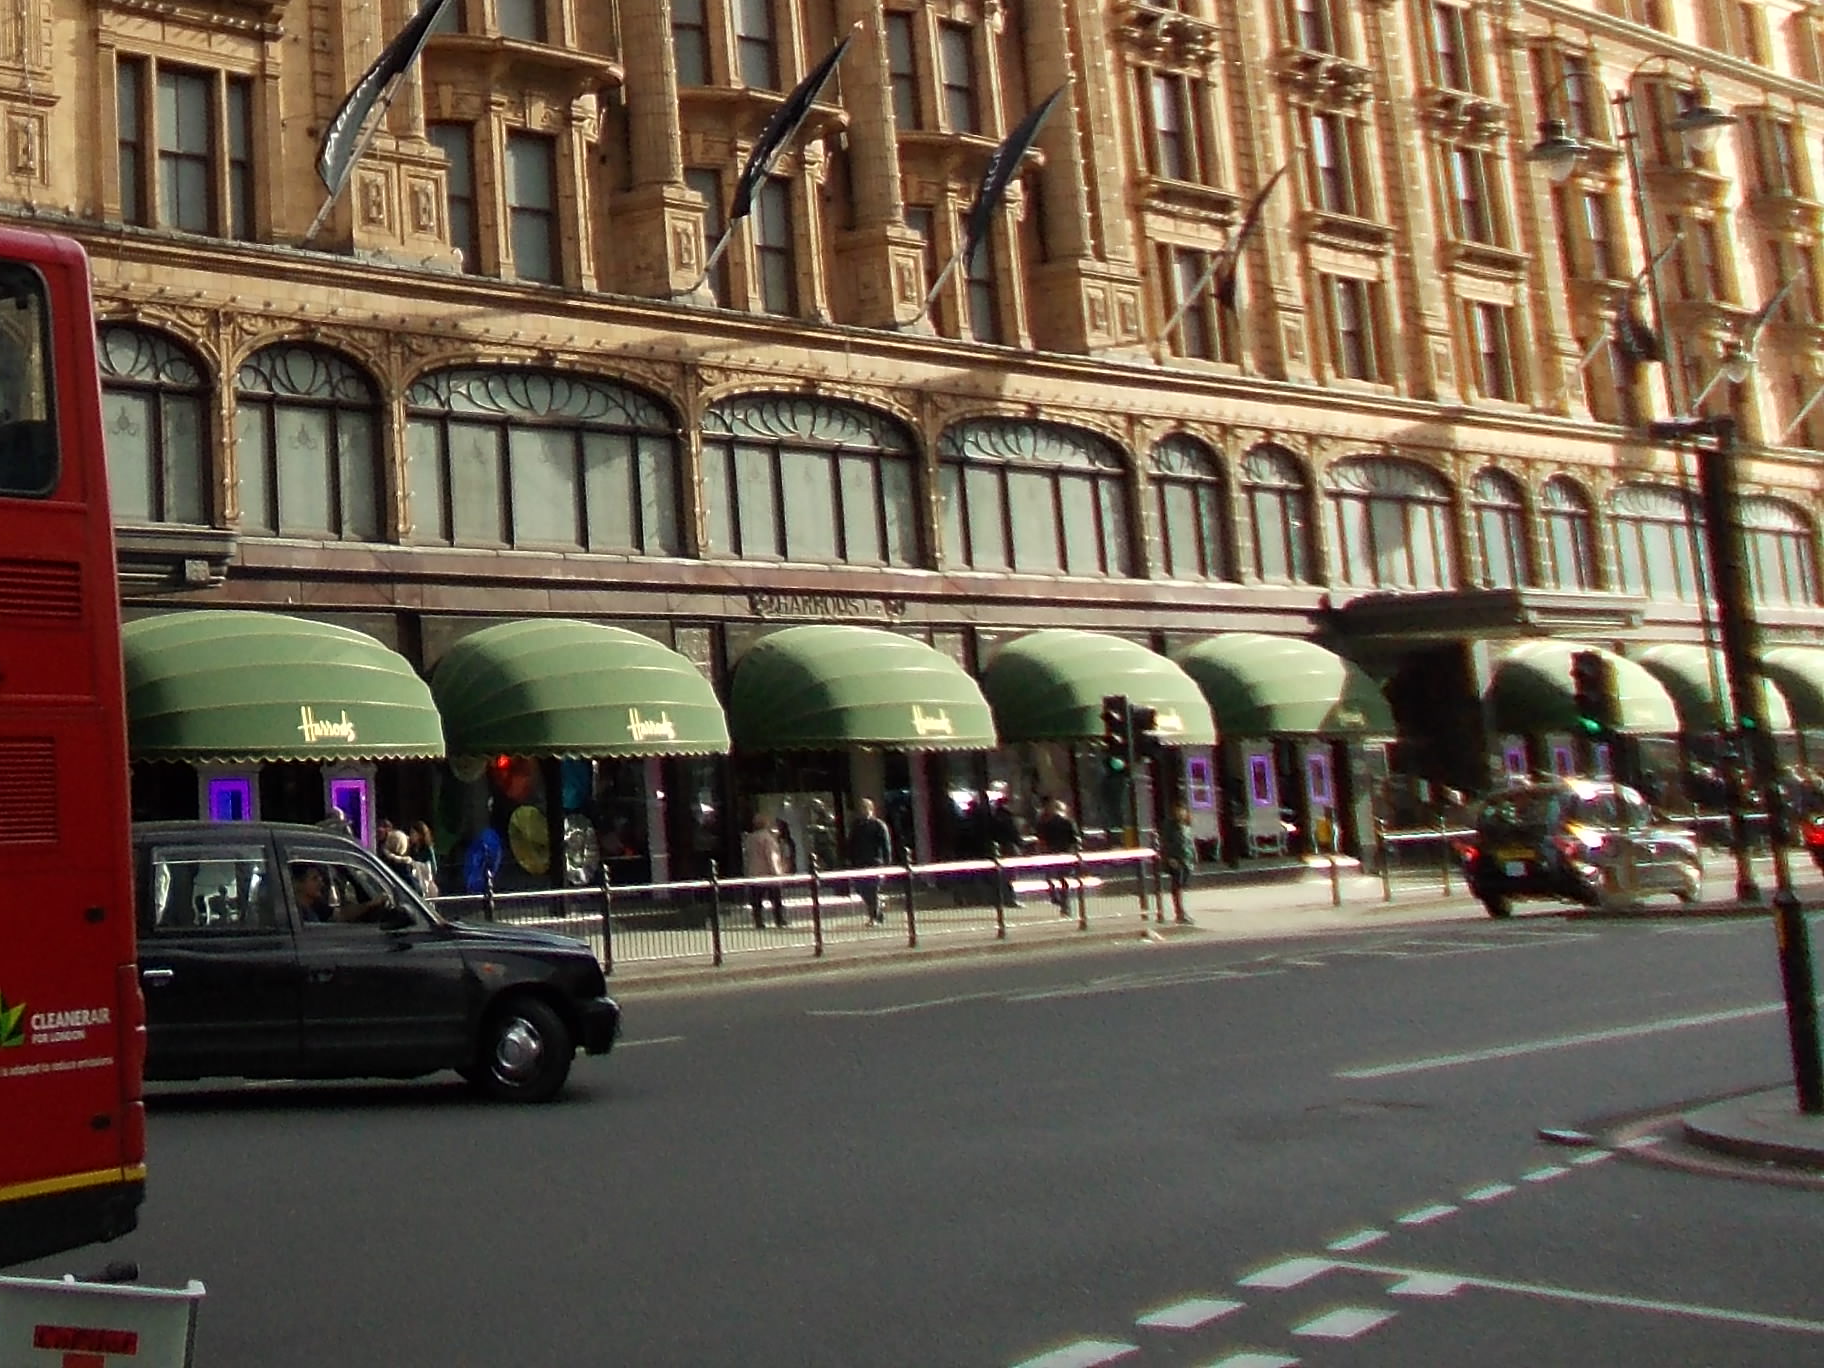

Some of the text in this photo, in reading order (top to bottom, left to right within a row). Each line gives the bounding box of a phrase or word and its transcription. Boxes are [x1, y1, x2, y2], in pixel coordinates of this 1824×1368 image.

[297, 705, 356, 742] Harrods
[626, 707, 676, 741] Harrods
[50, 1030, 86, 1043] LONDON
